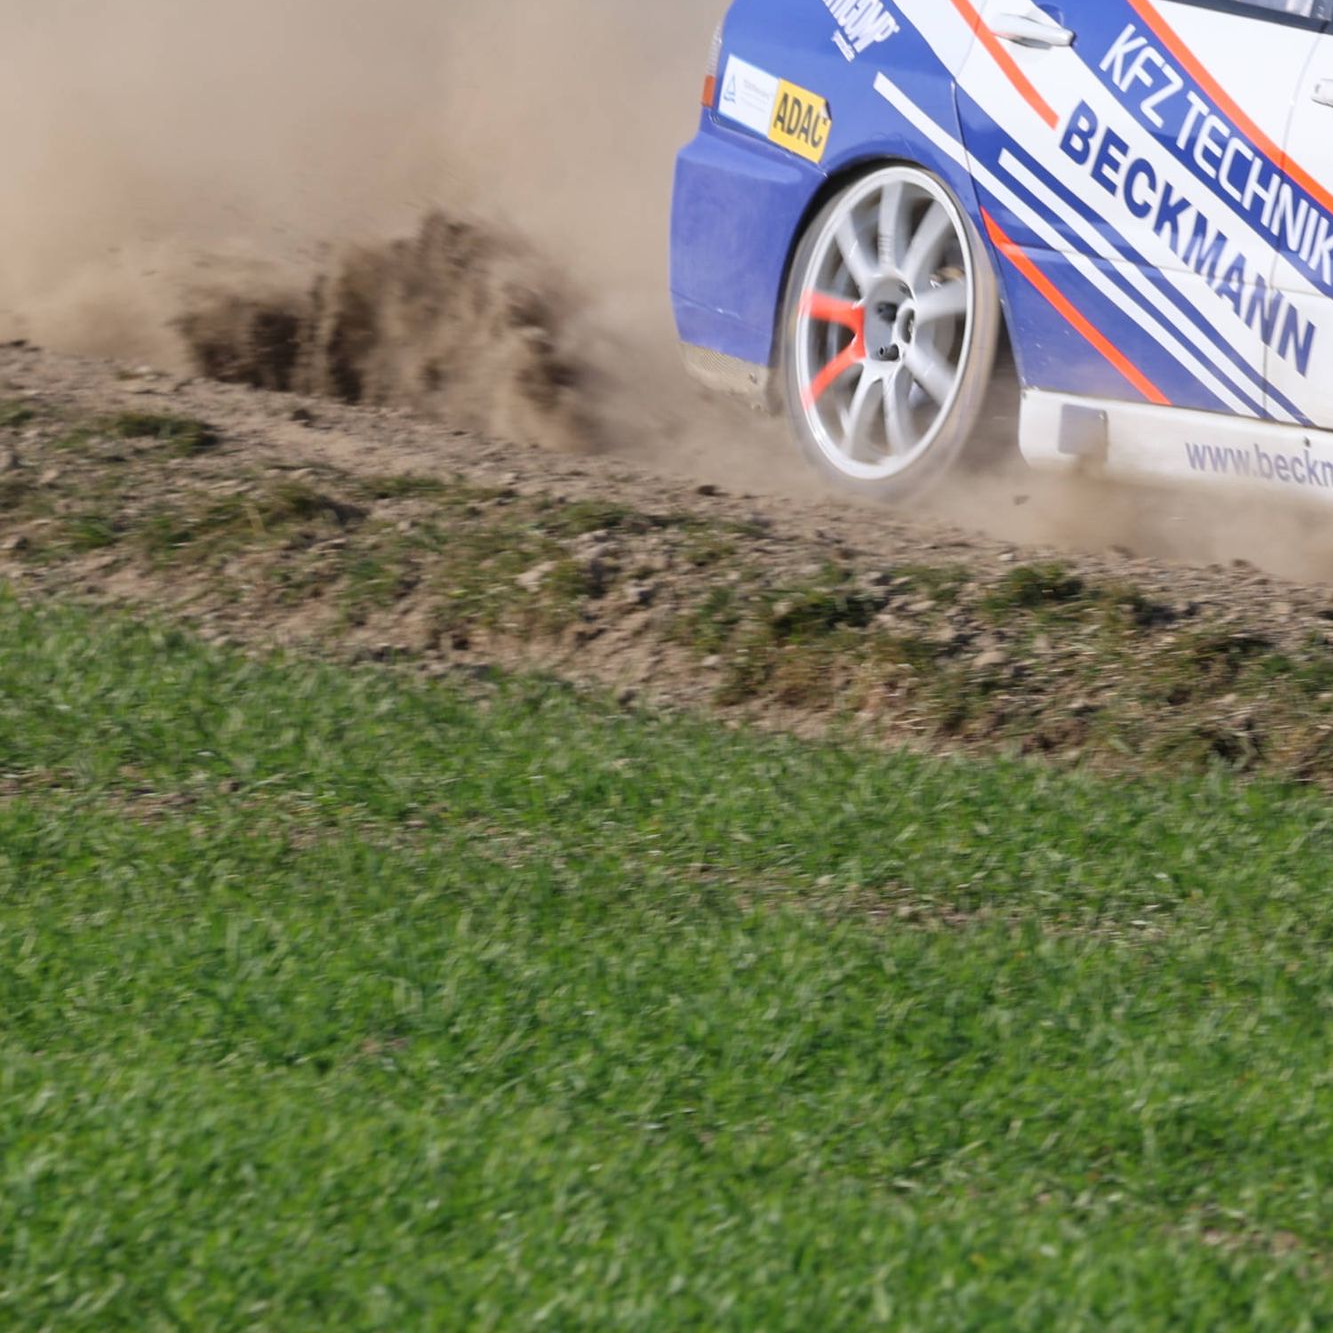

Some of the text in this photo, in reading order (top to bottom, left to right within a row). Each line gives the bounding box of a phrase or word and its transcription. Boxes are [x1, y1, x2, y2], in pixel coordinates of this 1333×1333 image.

[773, 92, 823, 150] ADAC
[1099, 23, 1184, 129] KFZ
[1059, 98, 1316, 378] BECKMANN
